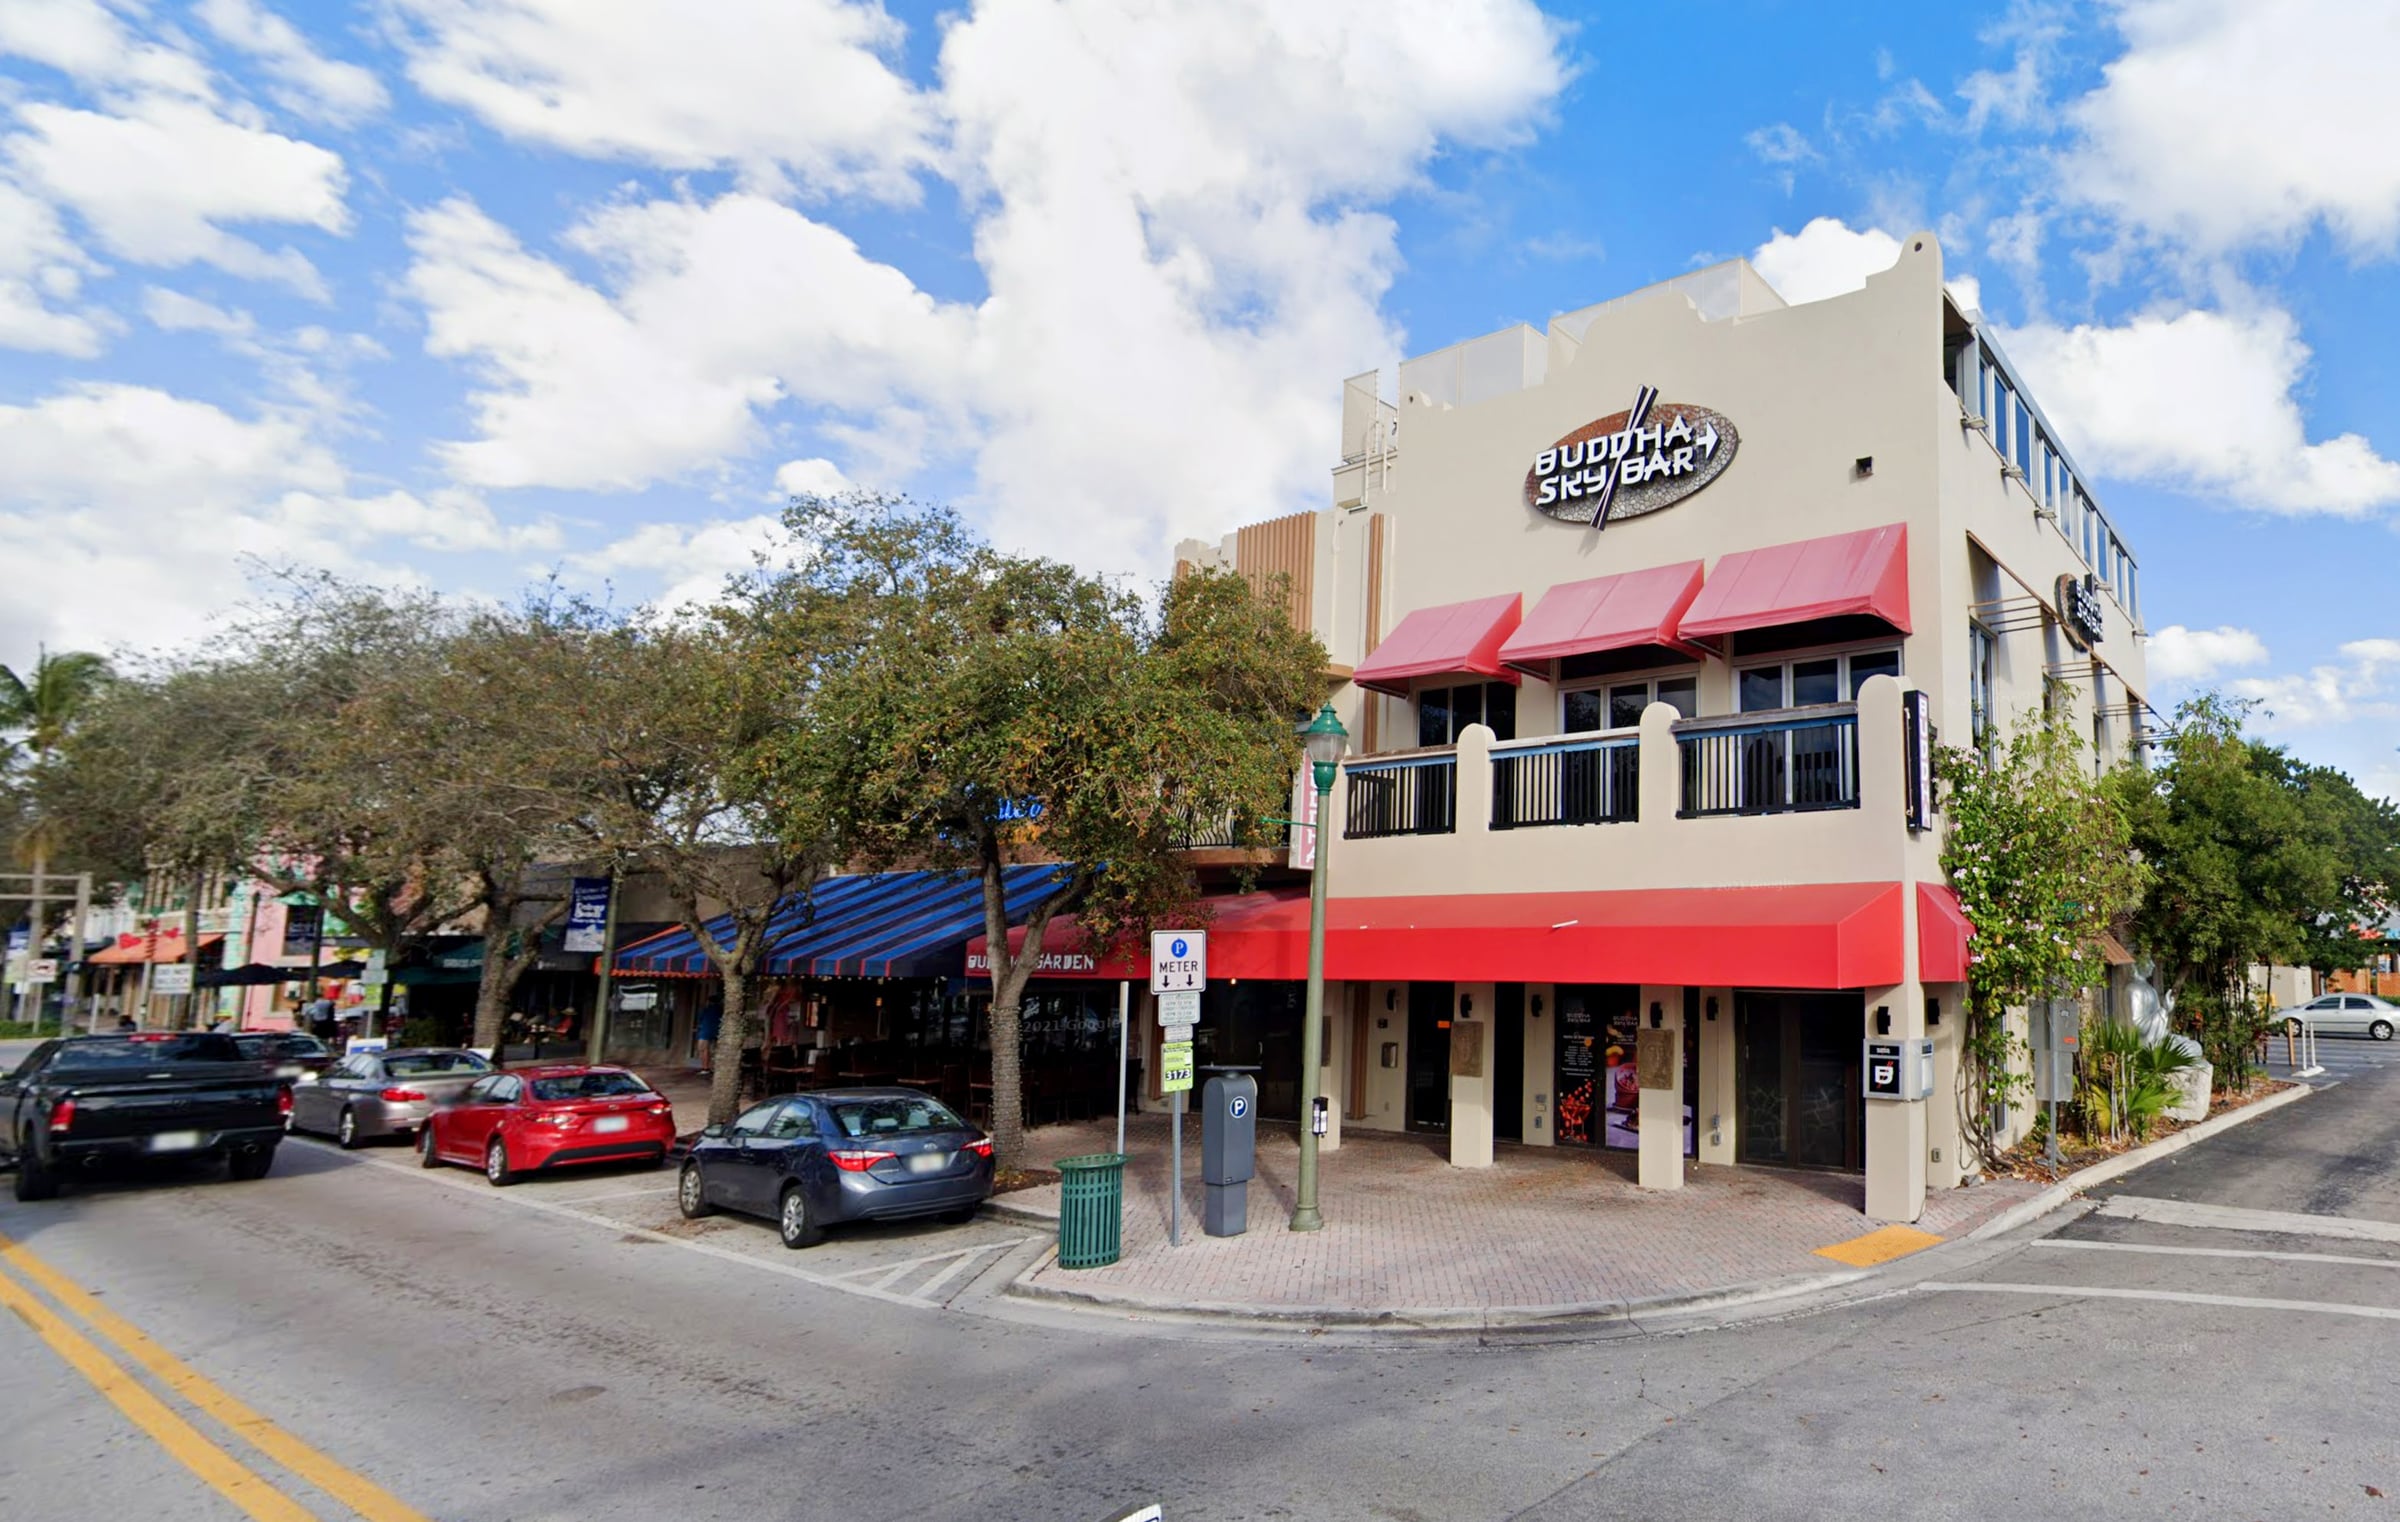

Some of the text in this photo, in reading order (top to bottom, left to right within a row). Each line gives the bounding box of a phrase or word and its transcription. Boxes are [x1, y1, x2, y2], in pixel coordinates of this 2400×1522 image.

[1535, 414, 1694, 476] BUDDHA
[1535, 446, 1695, 506] SKY BAR
[1037, 953, 1095, 970] GARDEN
[1159, 961, 1199, 973] METER
[1166, 1069, 1191, 1081] 3173
